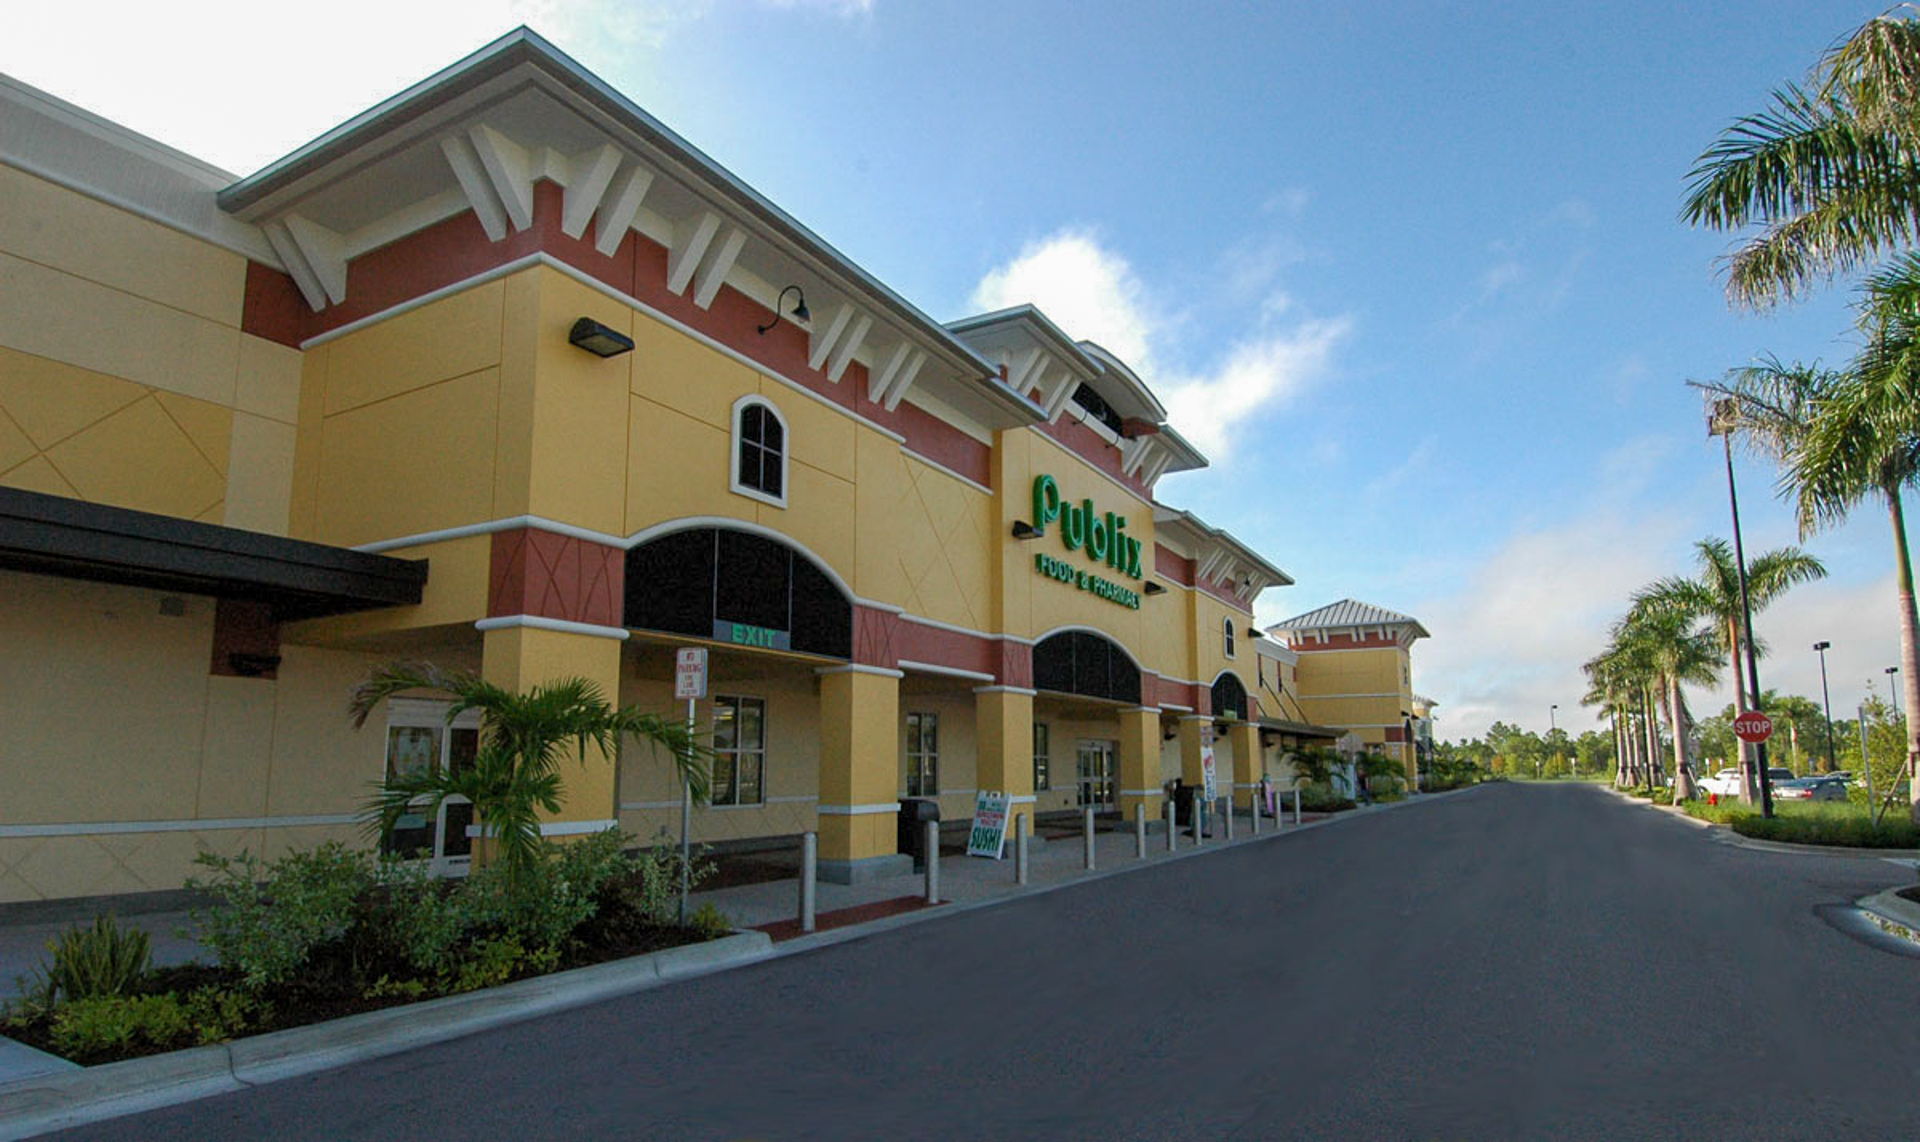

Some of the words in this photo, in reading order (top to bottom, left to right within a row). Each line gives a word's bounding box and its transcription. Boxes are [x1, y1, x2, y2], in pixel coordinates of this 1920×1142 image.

[1033, 474, 1143, 580] Publix
[1036, 553, 1075, 584] FOOD
[1076, 570, 1089, 590] &
[1089, 575, 1141, 610] PHARMACY
[731, 623, 775, 647] EXIT
[1735, 720, 1770, 734] STOP
[970, 827, 1001, 851] SUSHI
